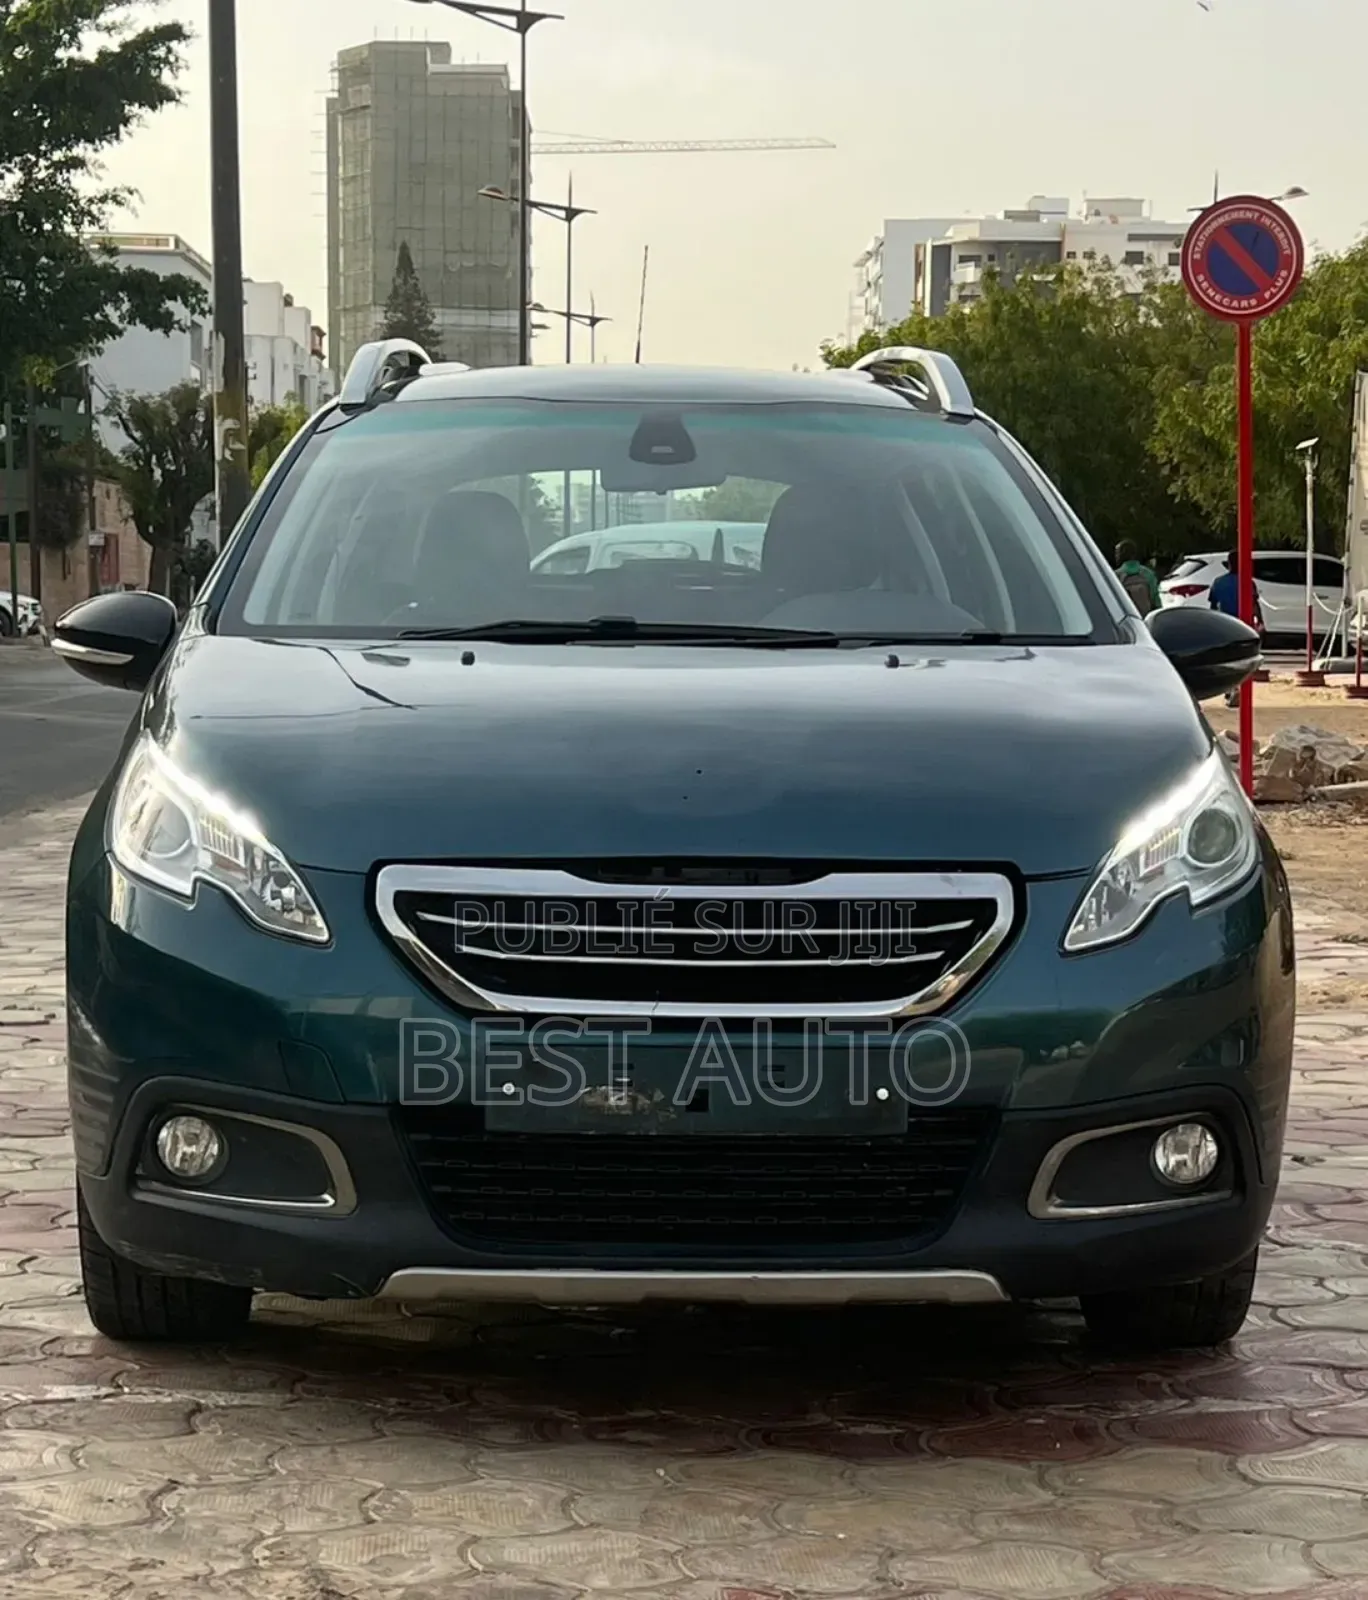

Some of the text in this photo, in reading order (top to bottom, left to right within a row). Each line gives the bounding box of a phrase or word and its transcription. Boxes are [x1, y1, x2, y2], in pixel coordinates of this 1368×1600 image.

[1193, 210, 1292, 260] STATIONNEMENT INTERDIT
[1196, 269, 1289, 309] SENECARS PLUS
